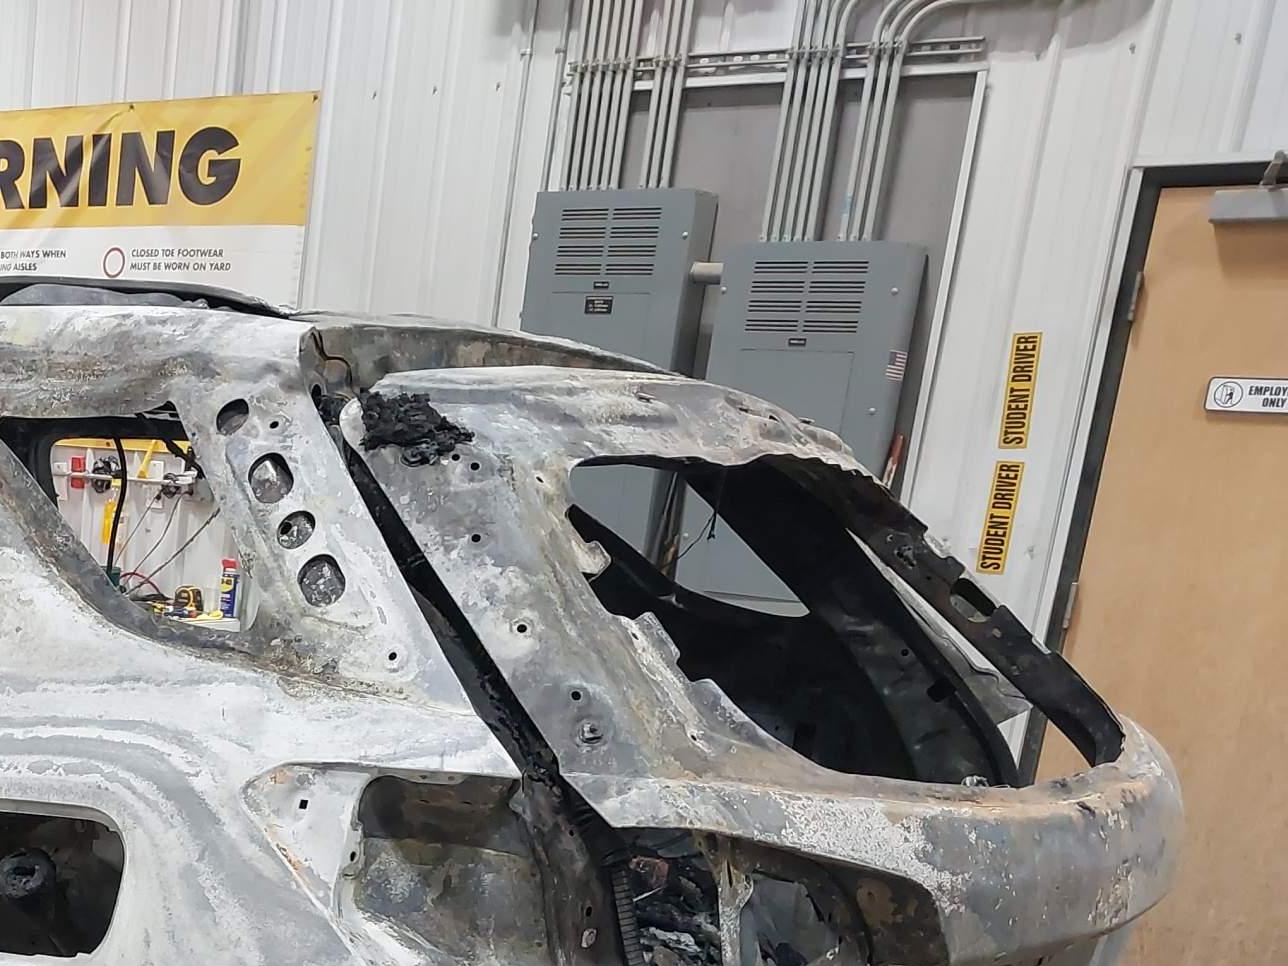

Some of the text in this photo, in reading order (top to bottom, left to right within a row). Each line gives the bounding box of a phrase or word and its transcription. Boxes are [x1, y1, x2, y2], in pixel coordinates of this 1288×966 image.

[0, 251, 19, 259] BOTH
[20, 249, 40, 259] WAYS
[41, 249, 67, 258] WHEN
[131, 248, 224, 258] CLOSED TOE FOOTWEAR
[13, 262, 38, 271] AISLES
[129, 261, 232, 271] MUST BE WORN ON YARD
[1003, 334, 1039, 446] STUDENT DRIVER
[1248, 385, 1288, 396] EMPLOY
[1262, 397, 1287, 408] ONLY
[980, 463, 1021, 571] STUDENT DRIVER
